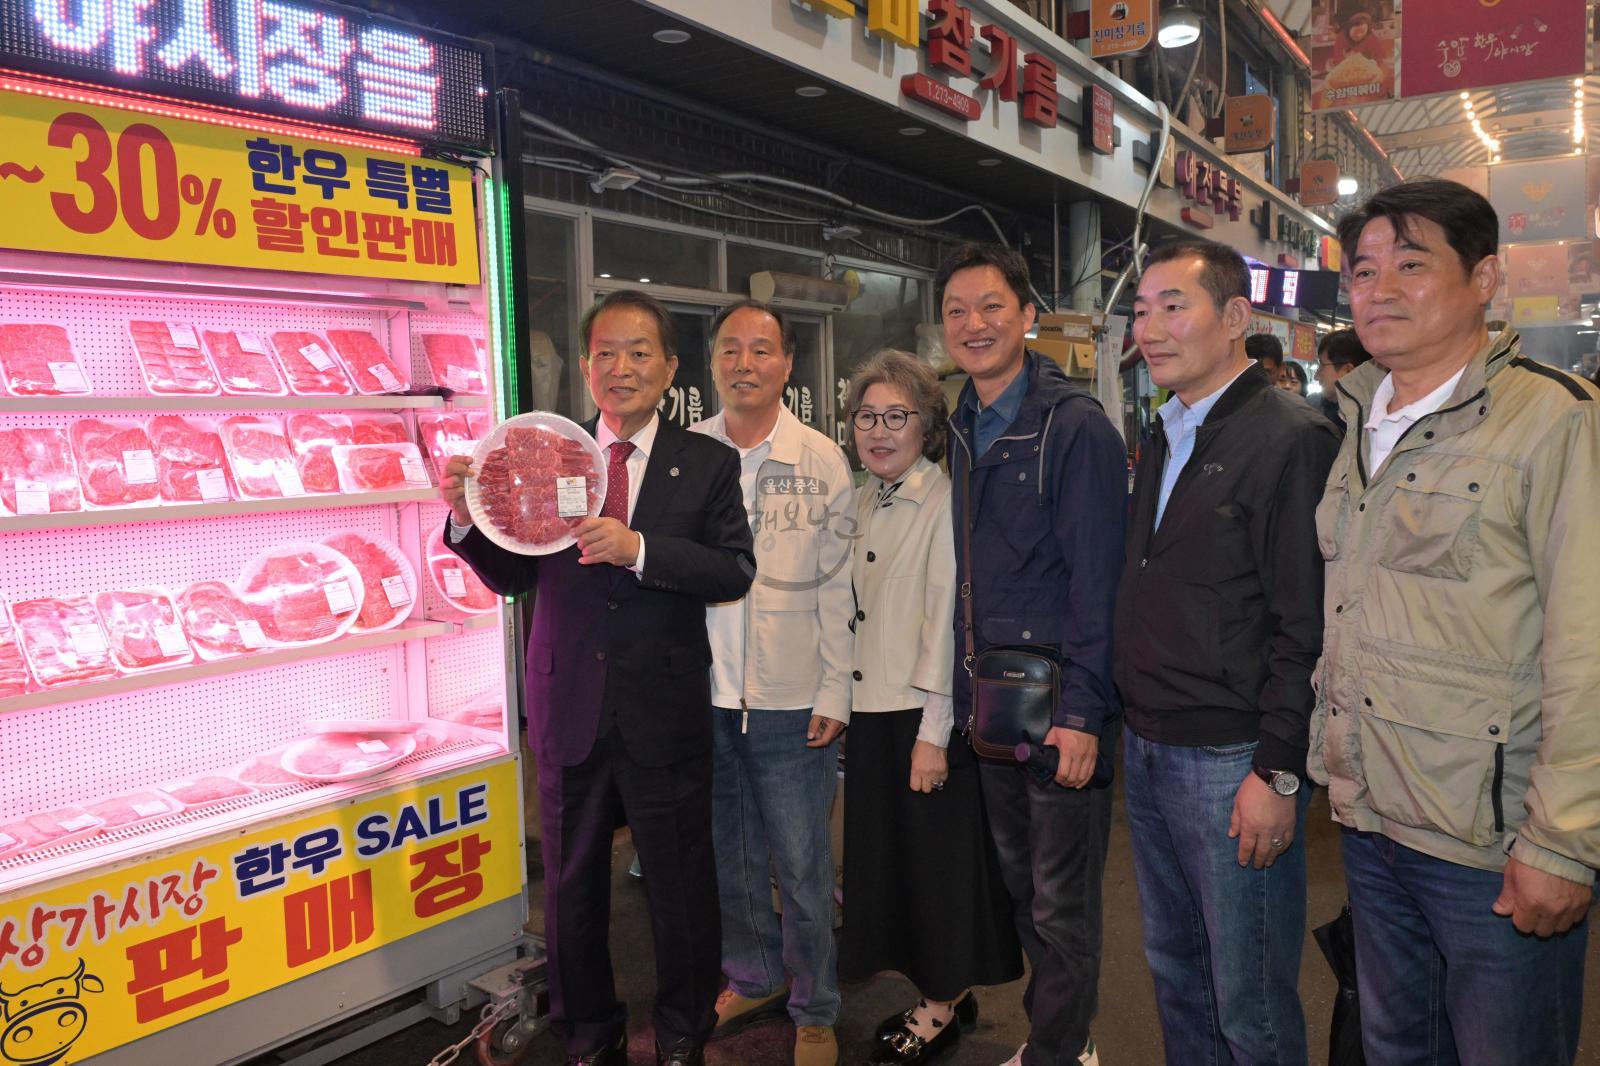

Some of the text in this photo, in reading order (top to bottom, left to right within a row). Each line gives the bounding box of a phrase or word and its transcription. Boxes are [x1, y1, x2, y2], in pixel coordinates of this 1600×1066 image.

[927, 0, 1057, 129] 참기름
[246, 137, 452, 215] 한우 특별
[250, 197, 458, 267] 할인판매
[234, 827, 342, 897] 한우
[357, 784, 488, 856] SALE
